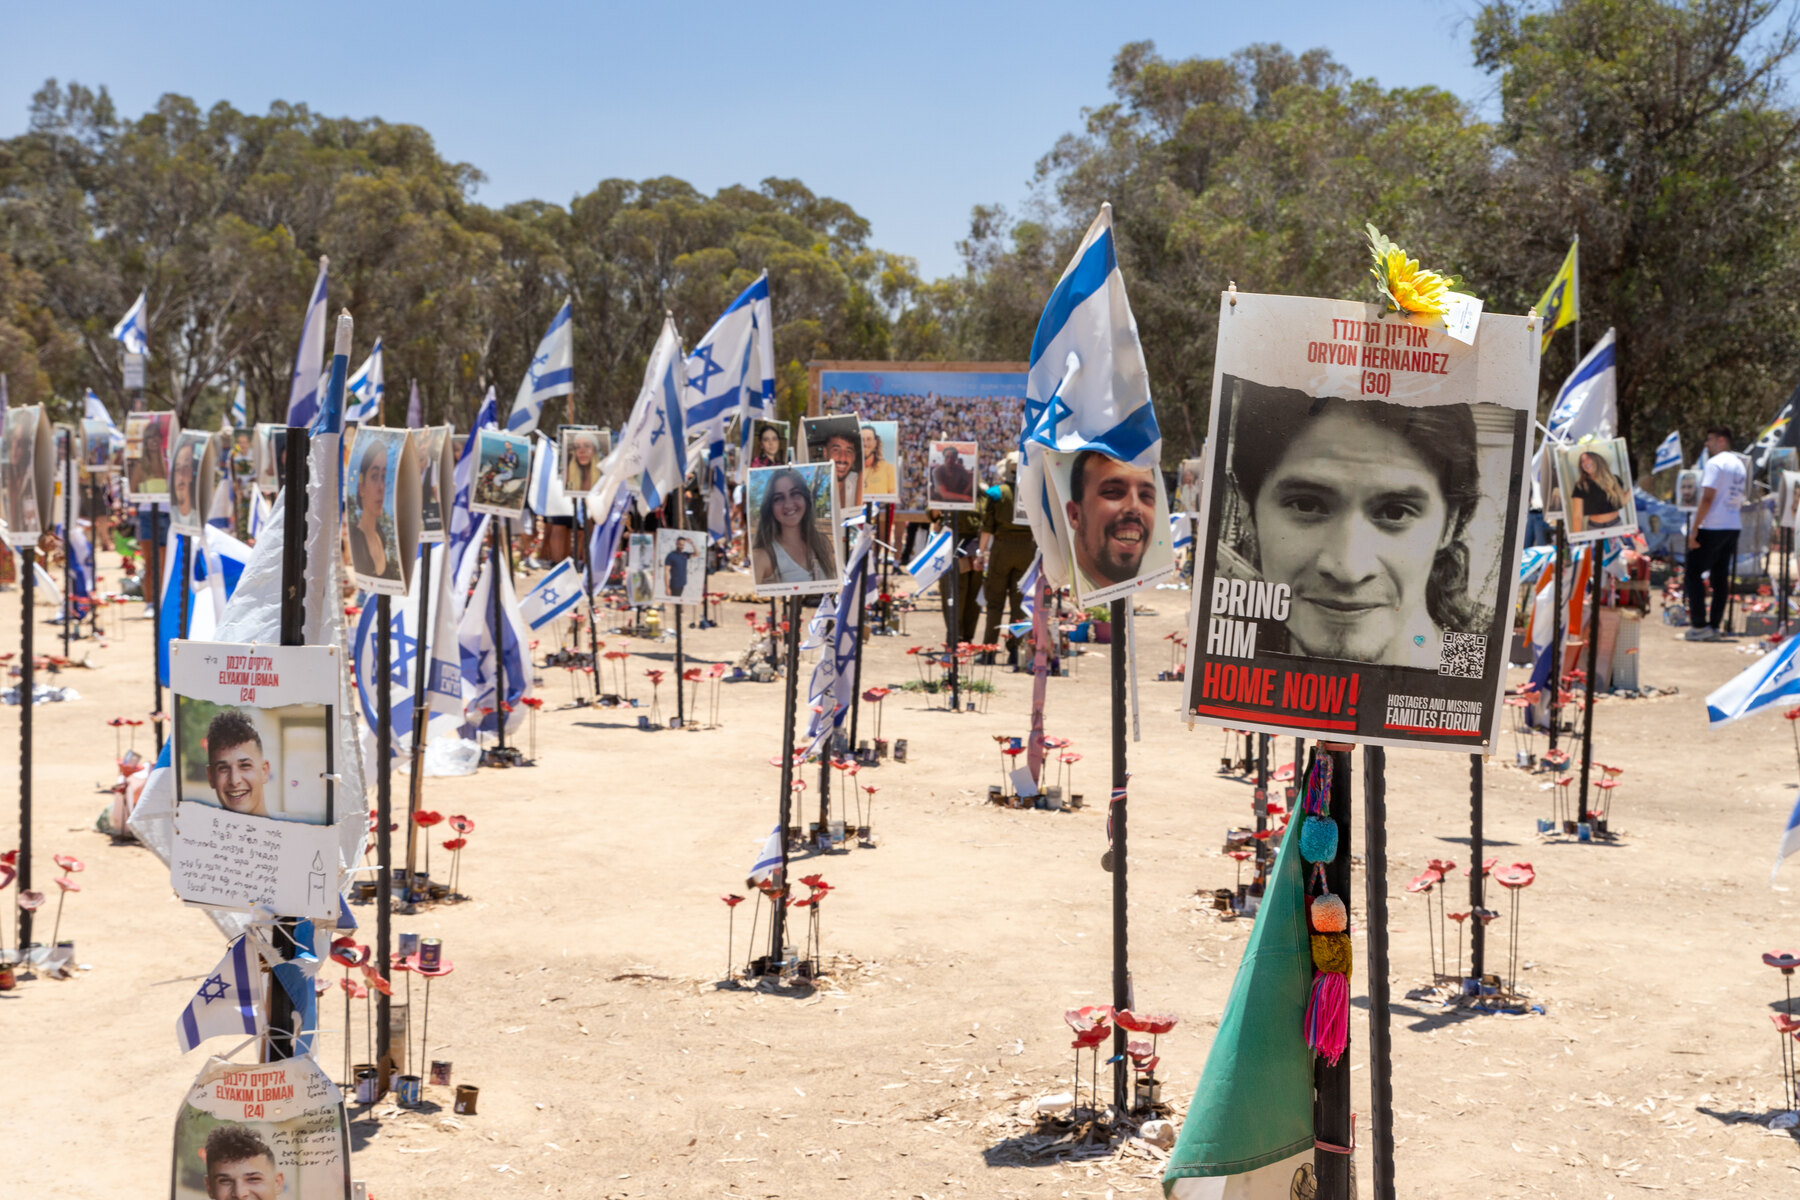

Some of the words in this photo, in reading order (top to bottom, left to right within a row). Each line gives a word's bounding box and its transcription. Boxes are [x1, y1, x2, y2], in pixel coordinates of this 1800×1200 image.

[1332, 318, 1381, 344] הרננדז
[1385, 323, 1428, 348] אוריון
[1307, 341, 1358, 366] ORYON
[1361, 346, 1449, 375] HERNANDEZ
[1361, 369, 1391, 397] (30)
[1211, 576, 1291, 621] BRING
[1206, 617, 1258, 660] HIM
[219, 671, 250, 685] ELYAKIM
[250, 673, 279, 687] LIBMAN
[1202, 661, 1277, 706] HOME
[1282, 671, 1360, 716] NOW!
[240, 687, 255, 703] (24)
[1387, 694, 1428, 710] HOSTAGES
[1429, 698, 1446, 711] AND
[1447, 699, 1482, 714] MISSING
[1385, 707, 1438, 729] FAMILIES
[1439, 711, 1481, 732] FORUM
[250, 1070, 286, 1088] אליקים
[216, 1085, 254, 1102] ELYAKIM
[257, 1084, 294, 1102] LIBMAN
[244, 1104, 265, 1119] (24)
